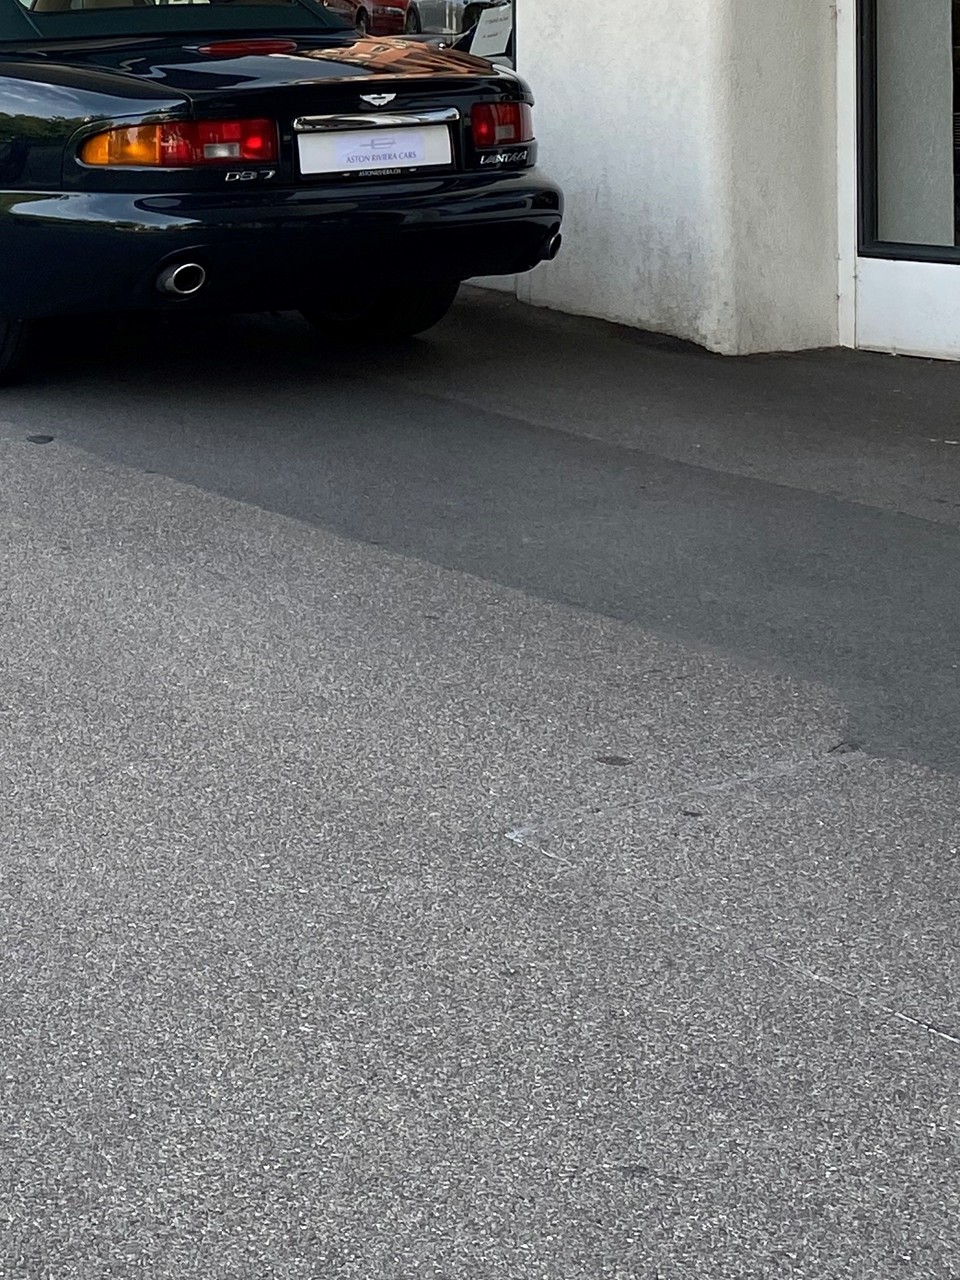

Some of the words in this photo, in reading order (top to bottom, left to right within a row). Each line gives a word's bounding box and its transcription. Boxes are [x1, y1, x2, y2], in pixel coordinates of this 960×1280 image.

[346, 154, 370, 163] ASTON
[371, 152, 397, 161] RIVIERA
[398, 150, 416, 159] CARS
